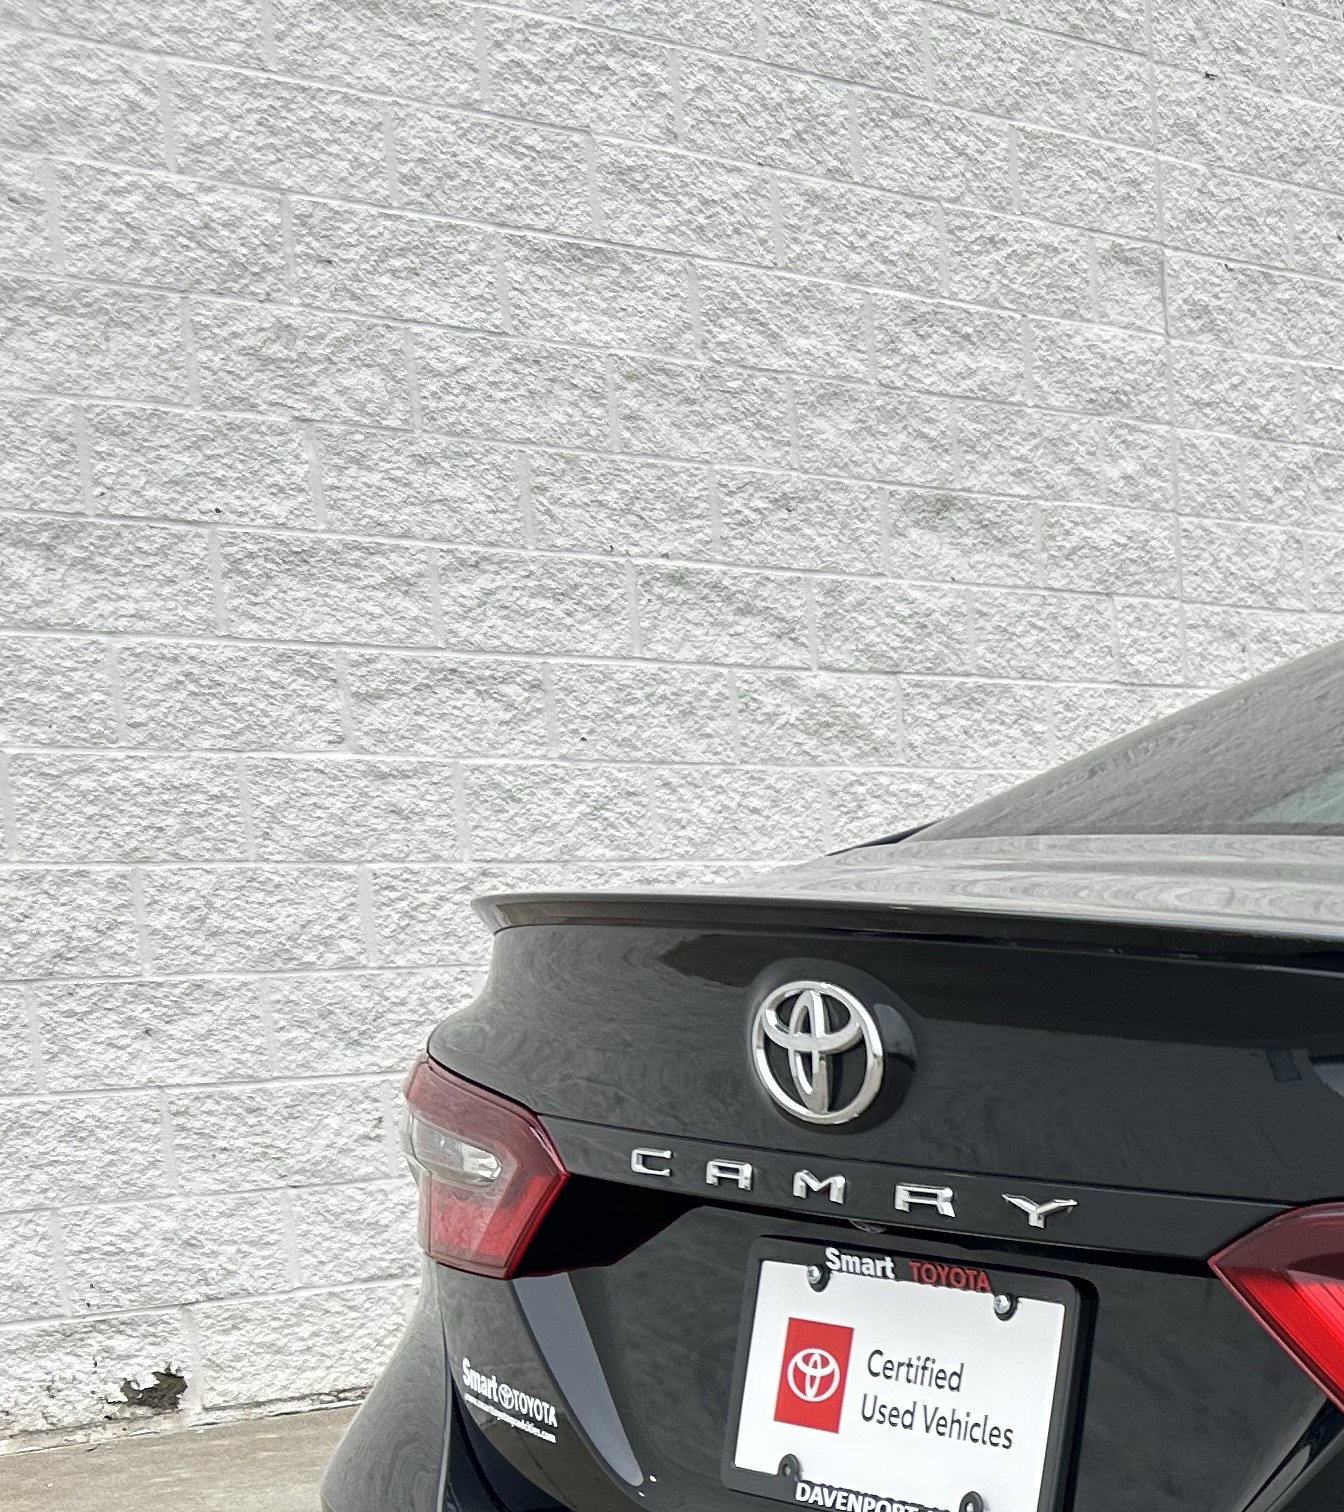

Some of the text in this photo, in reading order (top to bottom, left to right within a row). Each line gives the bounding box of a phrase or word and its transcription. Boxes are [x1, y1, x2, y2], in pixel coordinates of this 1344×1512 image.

[631, 1147, 1078, 1229] CAMRY
[825, 1247, 992, 1293] Smart TOYOTA
[462, 1357, 558, 1428] Smart TOYOTA
[867, 1349, 965, 1393] Certified
[861, 1392, 1014, 1449] Used Vehicles
